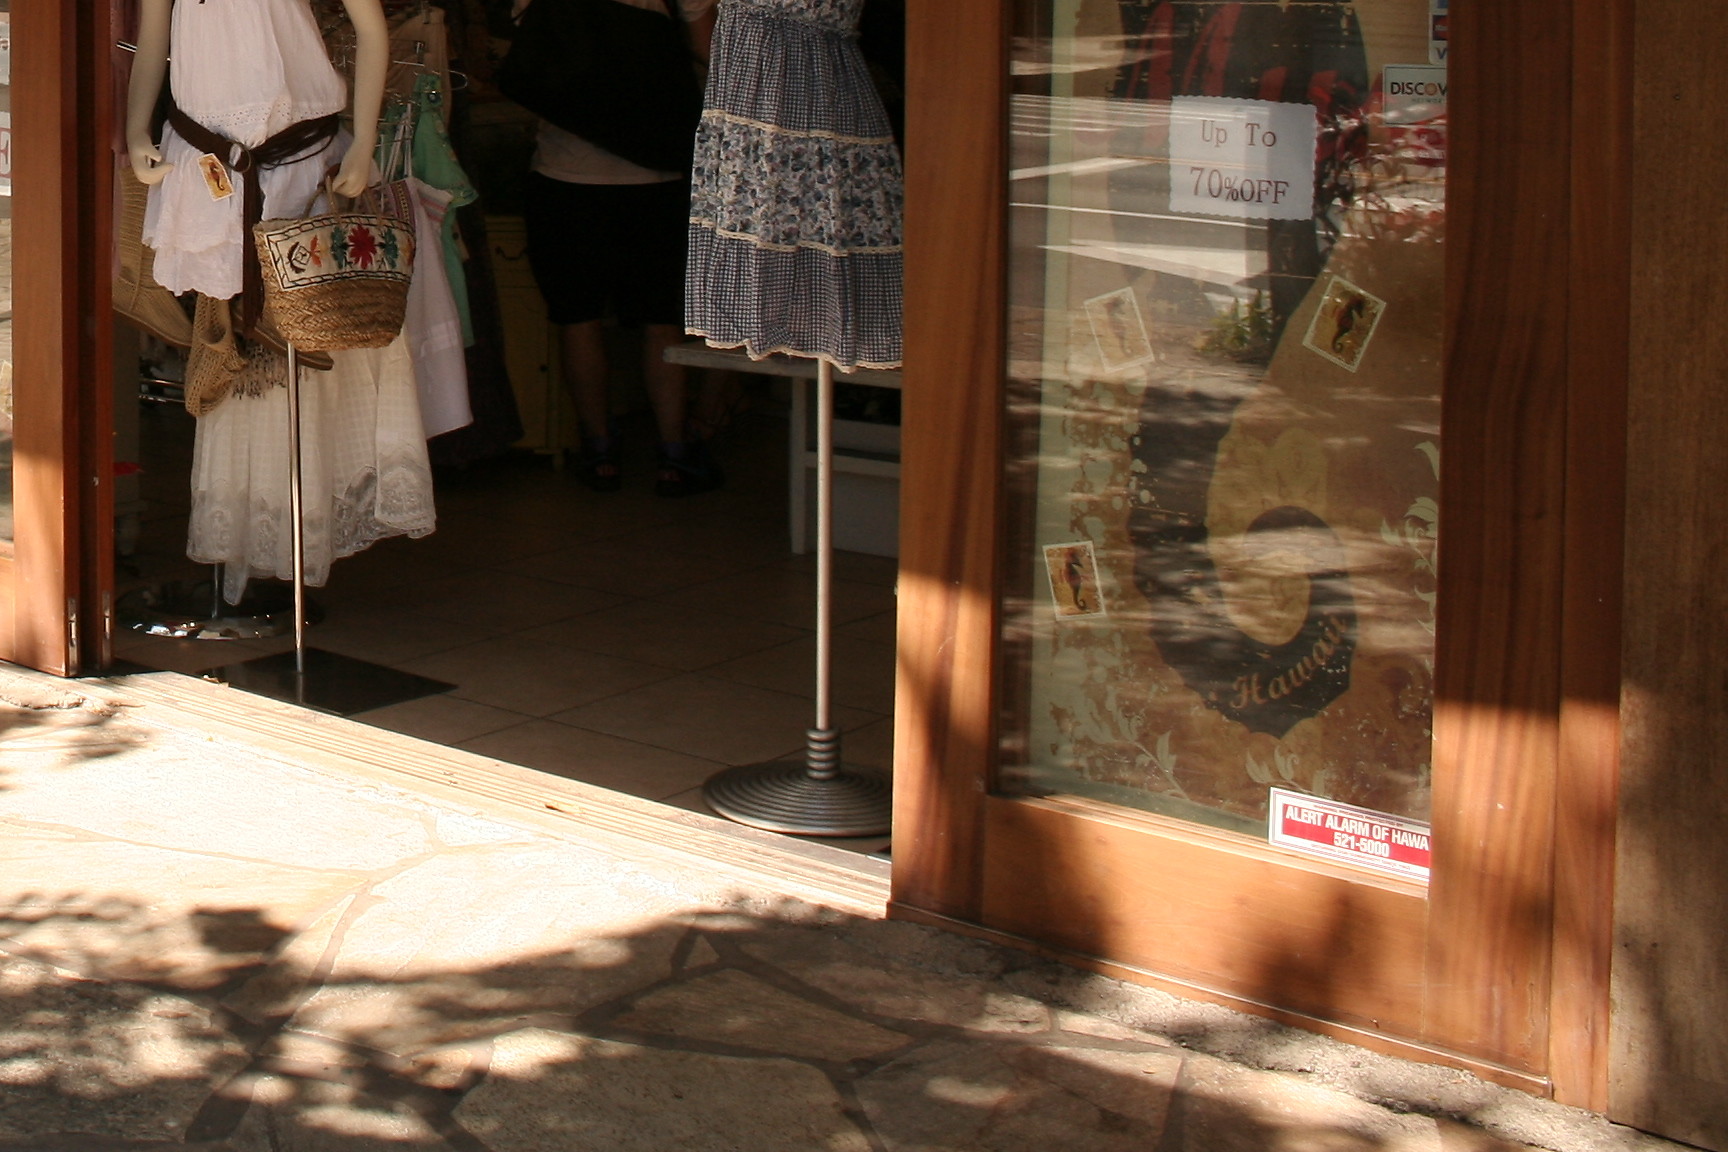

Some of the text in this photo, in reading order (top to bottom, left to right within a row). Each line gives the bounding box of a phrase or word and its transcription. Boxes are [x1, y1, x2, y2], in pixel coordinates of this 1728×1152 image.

[1201, 119, 1278, 148] Up To
[1285, 804, 1324, 828] ALERT
[1325, 814, 1370, 838] ALARM
[1372, 824, 1390, 842] OF
[1332, 831, 1391, 858] 521-5000
